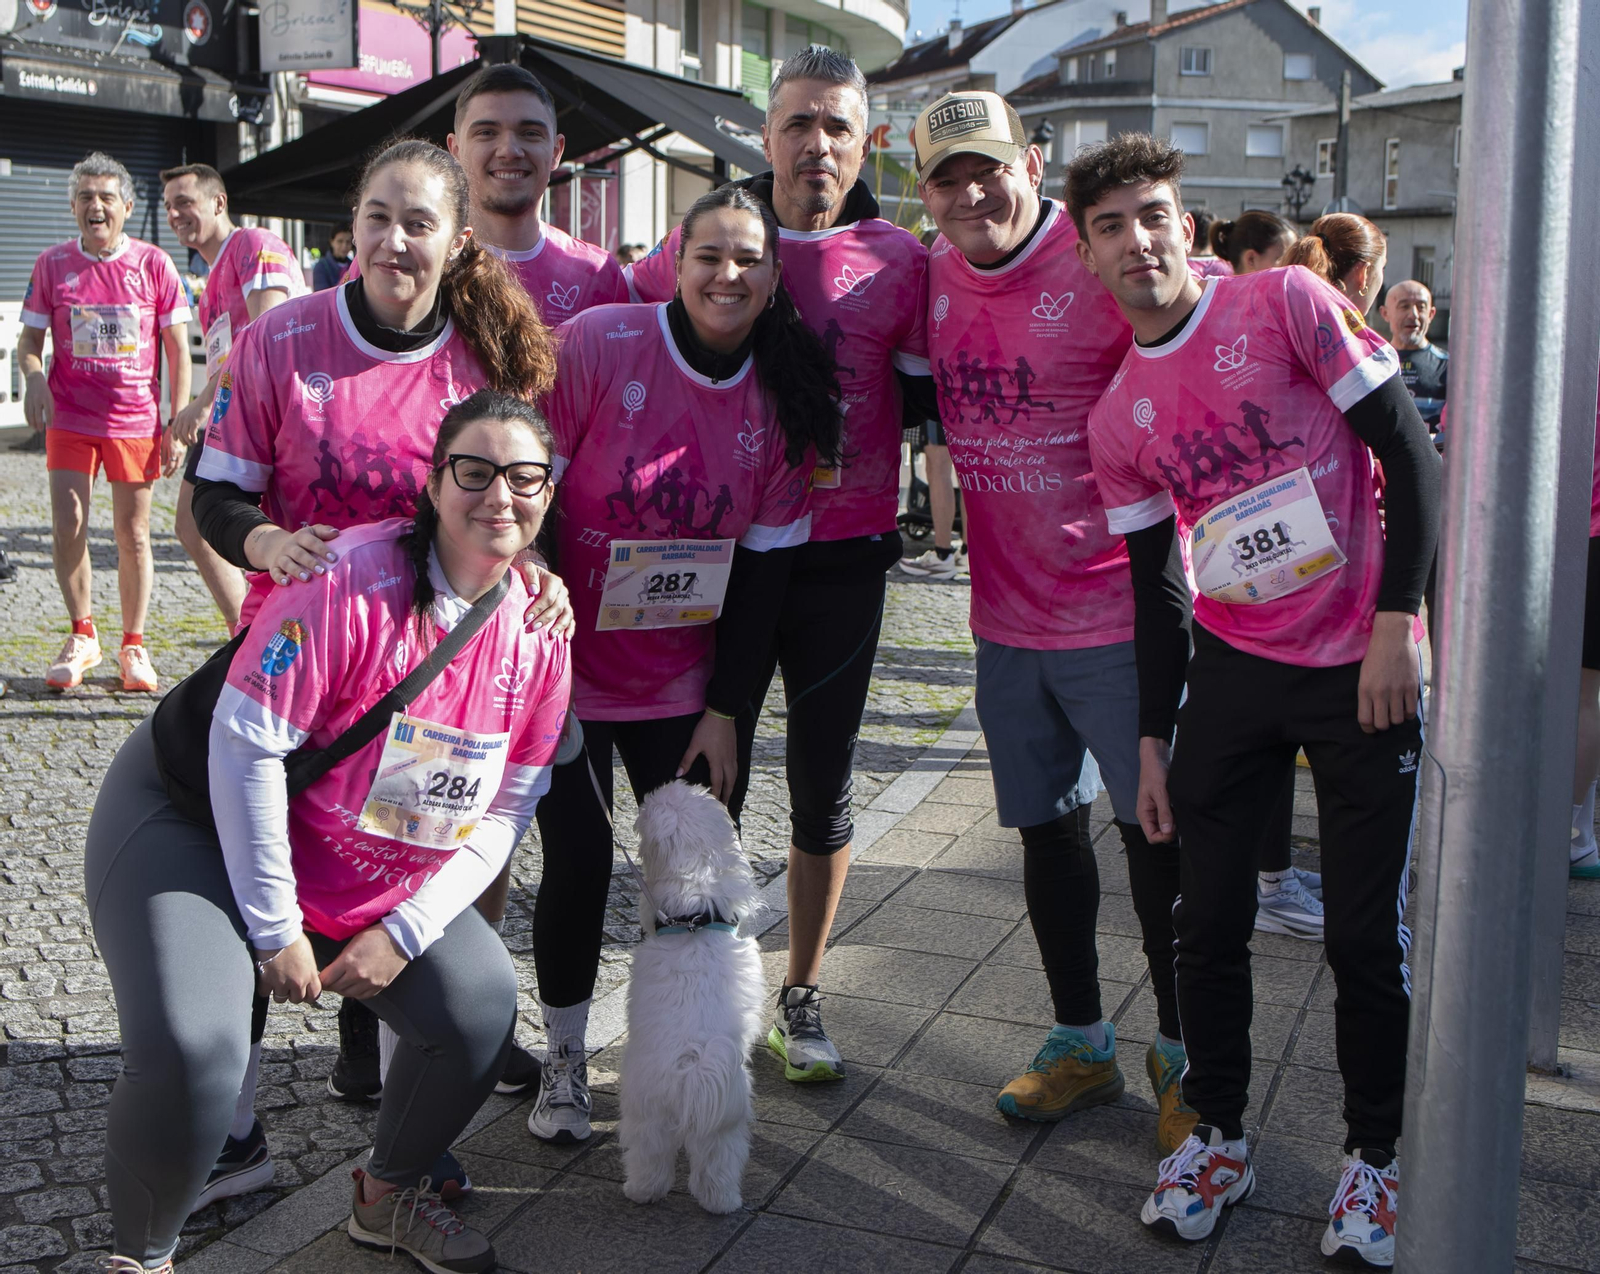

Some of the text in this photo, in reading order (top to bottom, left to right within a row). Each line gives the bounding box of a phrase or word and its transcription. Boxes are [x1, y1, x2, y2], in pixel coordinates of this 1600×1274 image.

[359, 53, 414, 80] ERFUMERÍA
[930, 101, 985, 129] STETSON
[942, 126, 959, 136] Since
[100, 323, 118, 335] 88
[957, 469, 1063, 494] arbadás
[1207, 478, 1298, 526] CARREIRA POLA IGUALDADE
[615, 544, 723, 562] III CARREIRA POLA IGUALDADE
[1235, 522, 1290, 561] 381
[648, 572, 697, 593] 287
[394, 722, 416, 744] III
[422, 728, 462, 746] CARREIRA
[462, 738, 481, 750] POLA
[1399, 764, 1417, 774] adidas
[427, 771, 482, 802] 284
